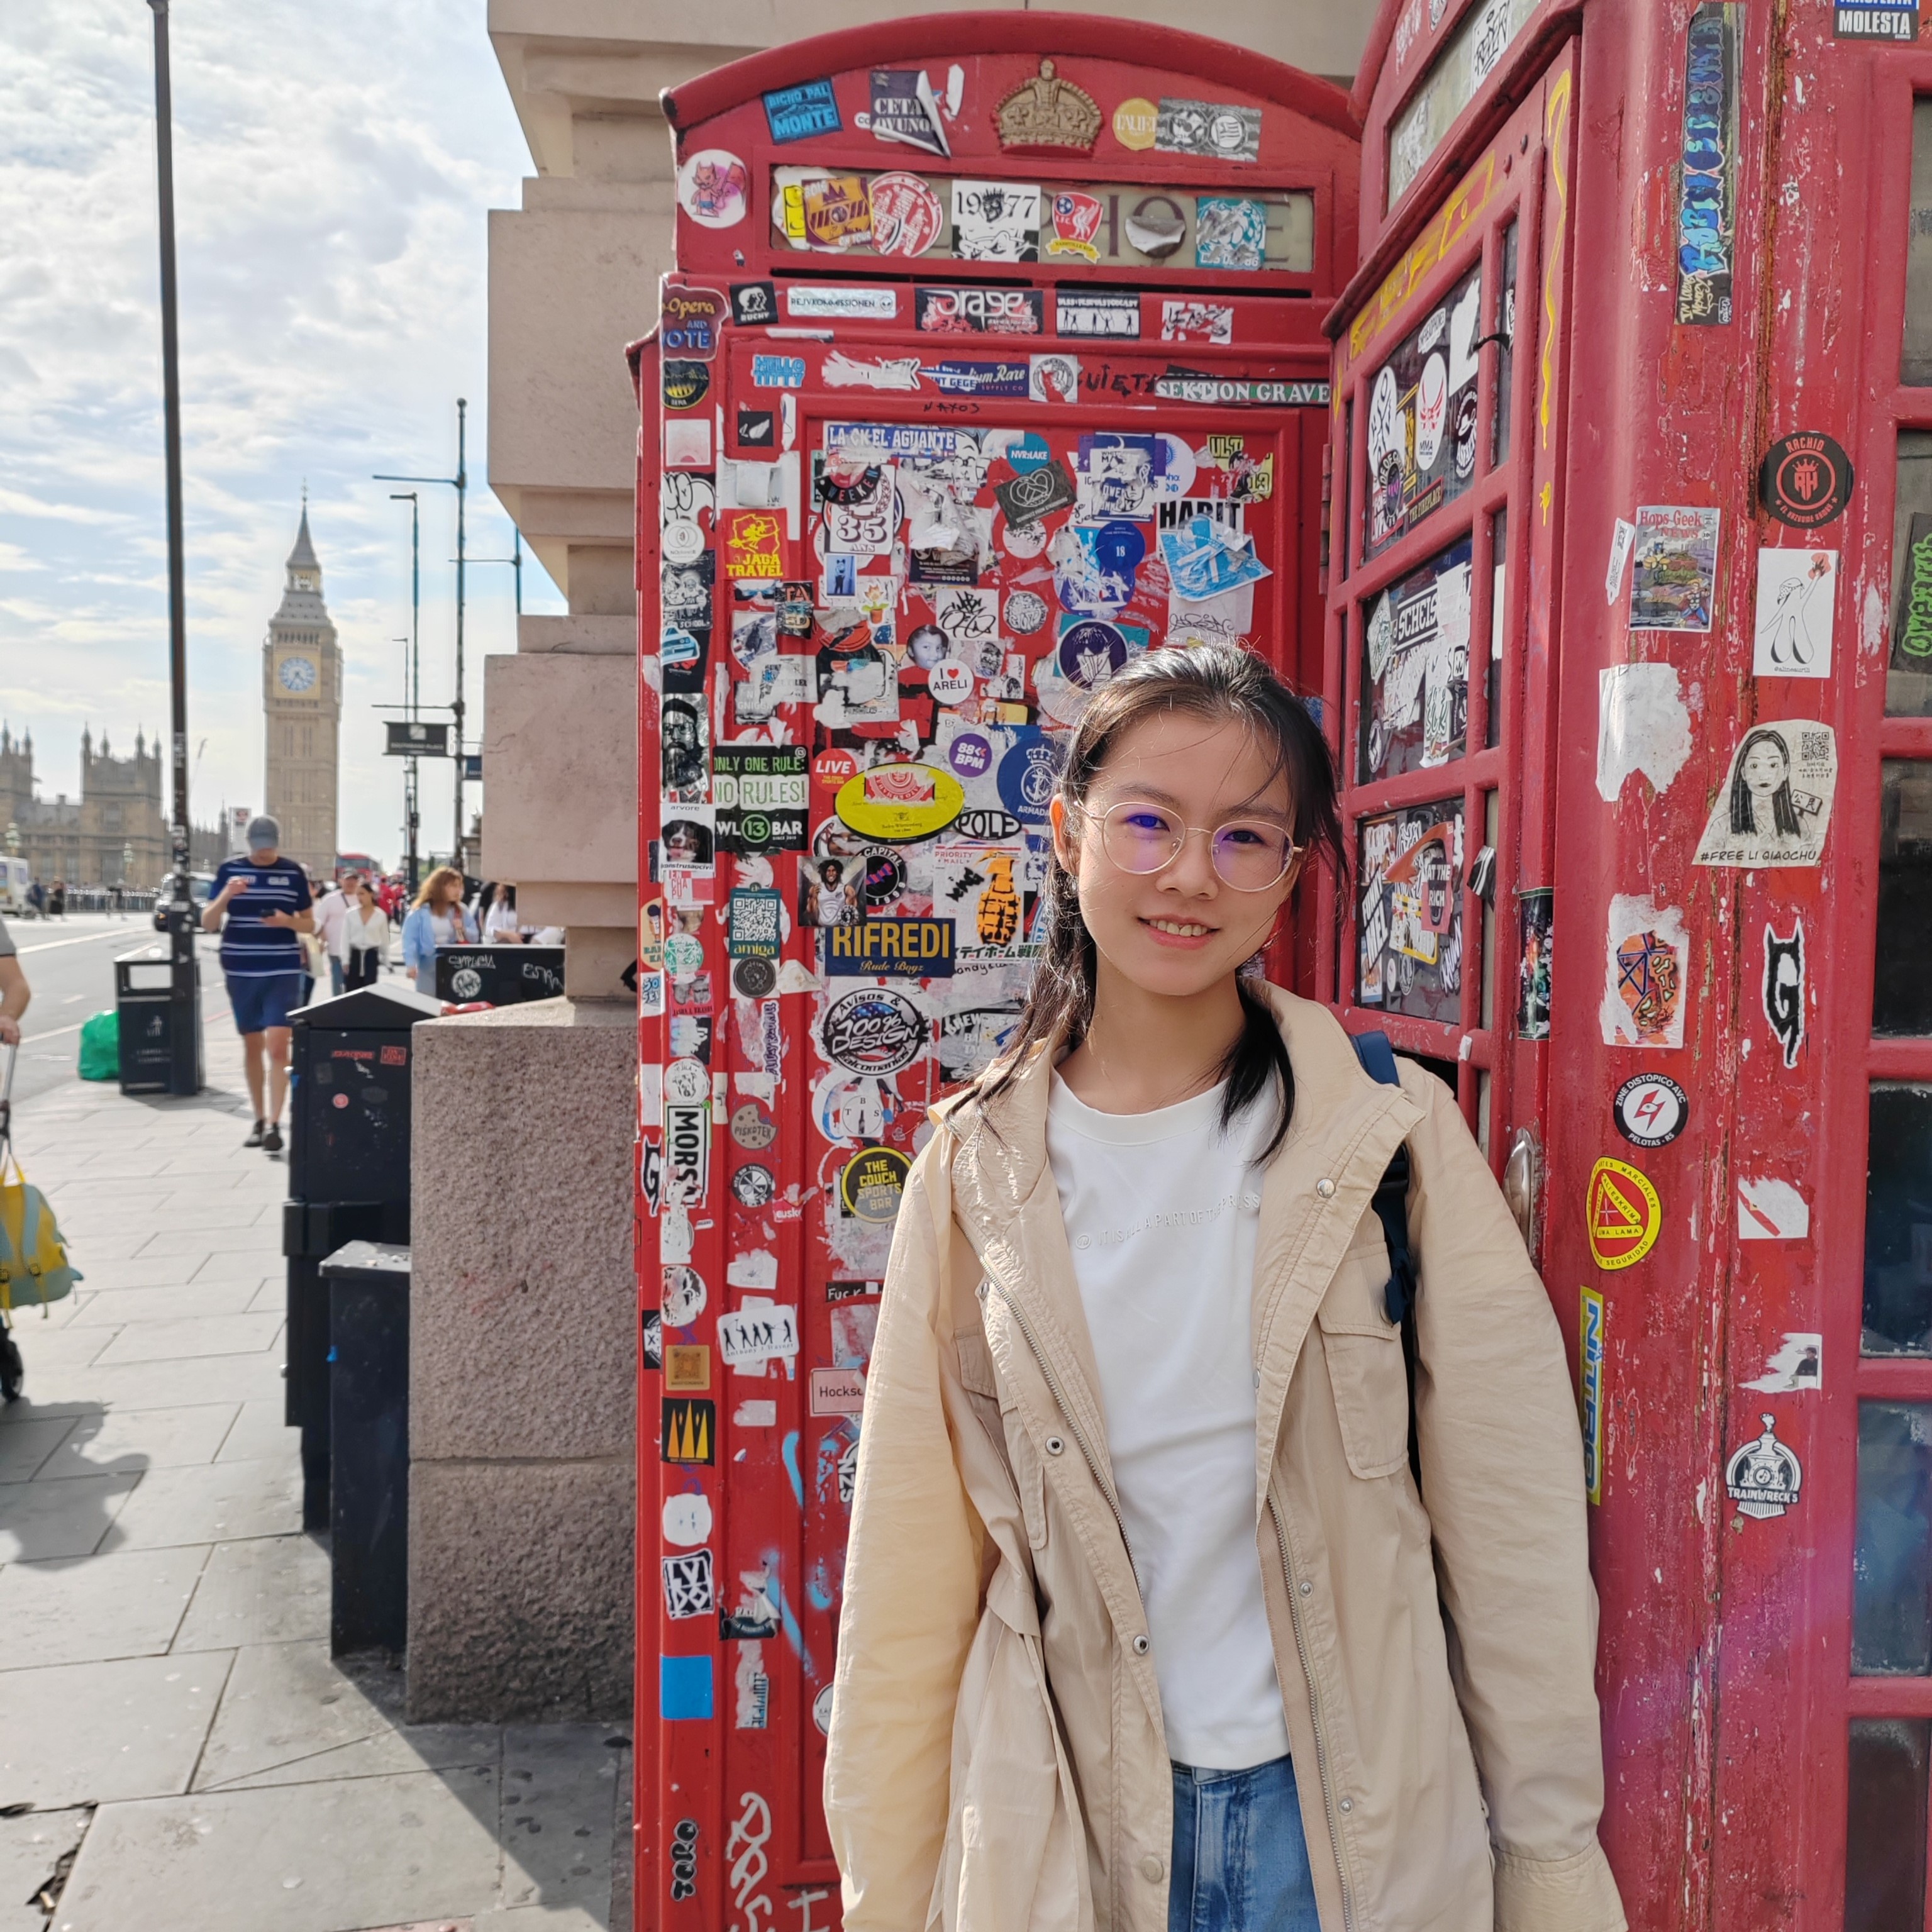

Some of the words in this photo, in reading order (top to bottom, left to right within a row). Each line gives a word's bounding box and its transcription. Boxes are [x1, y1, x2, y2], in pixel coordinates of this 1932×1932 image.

[1839, 10, 1911, 35] MOLESTA
[807, 86, 828, 101] PAL
[773, 111, 836, 136] MONTE
[687, 321, 708, 330] AND
[997, 365, 1026, 382] Rare
[1155, 380, 1251, 401] SEKTION
[892, 430, 955, 449] AGUANTE
[1419, 440, 1433, 451] MMA
[1785, 437, 1824, 453] RACHID
[1640, 511, 1669, 529] Hops
[1674, 511, 1704, 526] Geek
[838, 515, 888, 543] 35
[1661, 527, 1698, 538] NEWS
[850, 545, 876, 553] ANS
[1115, 545, 1126, 558] 18
[743, 553, 780, 565] JAGA
[726, 564, 784, 577] TRAVEL
[933, 679, 969, 691] ARELI
[745, 757, 769, 772] ONE
[772, 756, 806, 772] RULE:
[816, 760, 852, 775] LIVE
[954, 754, 985, 770] BPM
[714, 780, 735, 804] NO
[743, 779, 806, 804] RULES!
[1794, 794, 1816, 811] 公民
[771, 821, 803, 836] BAR
[864, 847, 901, 867] CAPITAL
[1700, 851, 1745, 862] #FREE
[1748, 851, 1759, 861] LI
[1762, 850, 1817, 861] QIAOCHU
[874, 880, 905, 904] 1999
[1428, 890, 1445, 907] RICH
[833, 923, 950, 958] RIFREDI
[733, 943, 775, 958] amiga
[859, 960, 891, 972] Rude
[840, 992, 885, 1016] Avisos
[891, 996, 901, 1006] &
[838, 1014, 902, 1036] 100%
[832, 1024, 921, 1055] DESIGN
[1616, 1087, 1629, 1107] ZINE
[1672, 1085, 1686, 1104] AVC
[1628, 1133, 1661, 1146] PELOTAS
[1665, 1132, 1675, 1141] RS
[865, 1160, 888, 1173] THE
[859, 1171, 897, 1187] COUCH
[857, 1182, 902, 1200] SPORTS
[1620, 1167, 1657, 1208] MARCIALES
[869, 1196, 894, 1211] BAR
[1610, 1191, 1640, 1224] ESKRIMA
[1112, 1230, 1124, 1243] IS
[1144, 1216, 1152, 1230] A
[1155, 1212, 1186, 1228] PART
[1190, 1210, 1203, 1224] OF
[1206, 1204, 1221, 1222] THE
[1615, 1226, 1640, 1235] LAMA
[1605, 1240, 1649, 1267] SEGURIDAD
